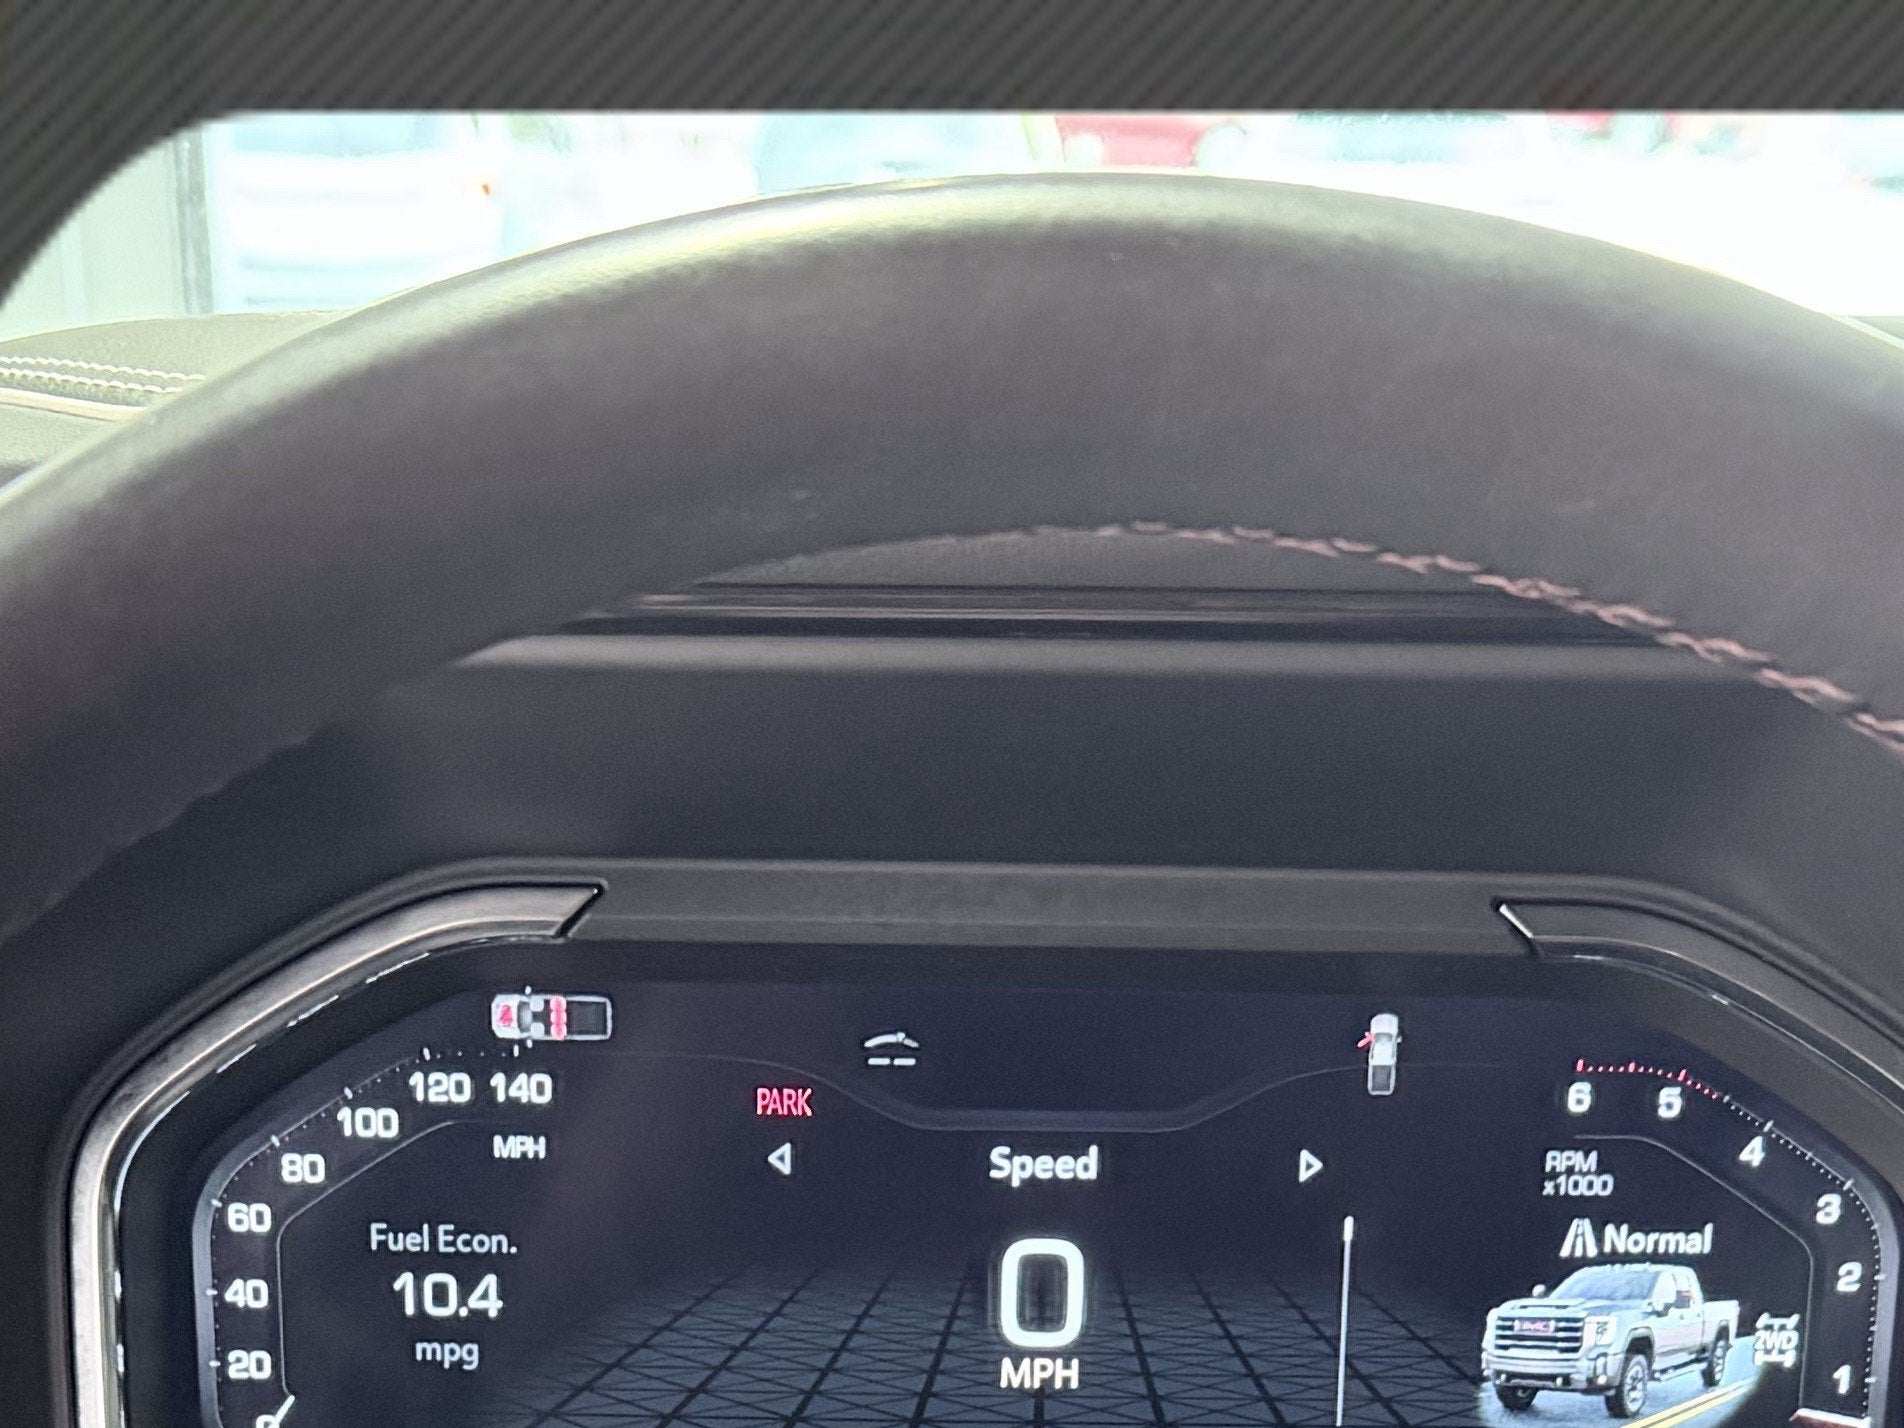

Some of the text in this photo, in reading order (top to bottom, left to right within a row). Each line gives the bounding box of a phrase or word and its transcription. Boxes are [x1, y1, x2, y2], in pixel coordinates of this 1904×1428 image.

[408, 1071, 472, 1103] 120
[489, 1071, 553, 1105] 140
[756, 1087, 813, 1117] PARK
[1567, 1080, 1592, 1114] 6
[1657, 1086, 1683, 1119] 5
[336, 1106, 399, 1139] 100
[493, 1134, 546, 1159] MPH
[1545, 1150, 1598, 1173] RPM
[1738, 1135, 1766, 1168] 4
[280, 1152, 326, 1184] 80
[989, 1144, 1099, 1185] Speed
[1542, 1173, 1615, 1197] x1000
[227, 1201, 272, 1233] 60
[1815, 1192, 1842, 1226] 3
[370, 1222, 518, 1255] Fuel Econ.
[1602, 1222, 1714, 1255] Normal
[223, 1277, 269, 1310] 40
[999, 1237, 1085, 1350] 0
[1836, 1260, 1864, 1294] 2
[392, 1271, 505, 1319] 10.4
[415, 1342, 480, 1370] mpg
[1752, 1328, 1801, 1351] 2WD
[227, 1349, 272, 1381] 20
[999, 1356, 1080, 1390] MPH
[1832, 1363, 1852, 1395] 1
